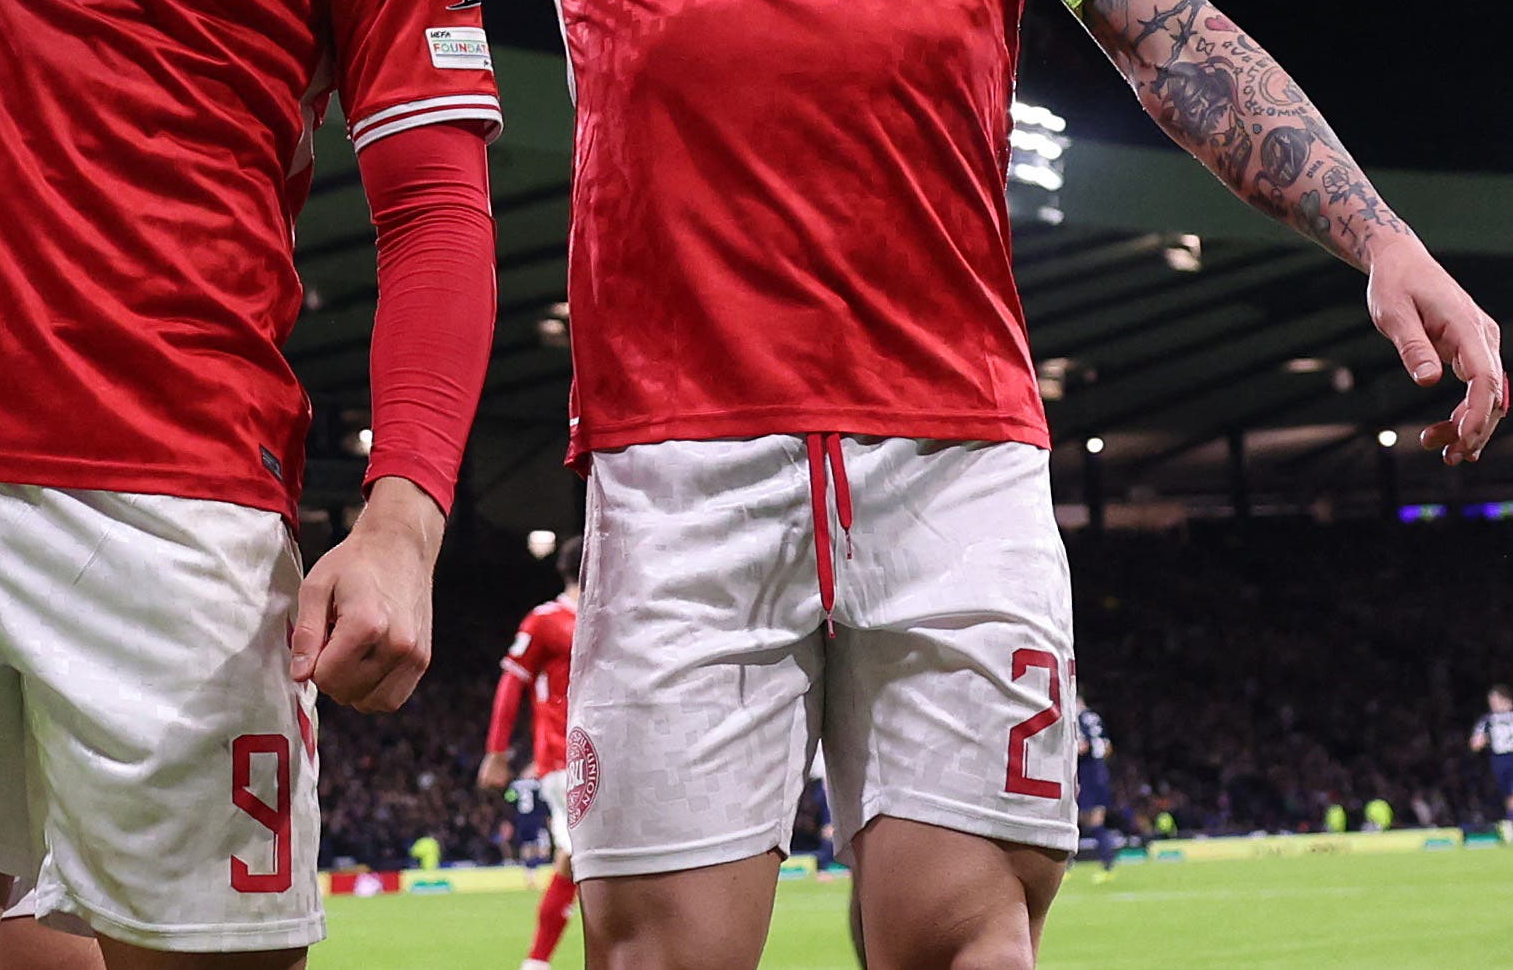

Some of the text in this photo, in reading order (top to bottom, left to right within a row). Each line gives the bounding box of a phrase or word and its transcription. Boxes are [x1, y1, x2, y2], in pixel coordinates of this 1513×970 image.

[581, 752, 596, 806] UNION
[1005, 648, 1079, 799] 2
[230, 734, 292, 893] 9
